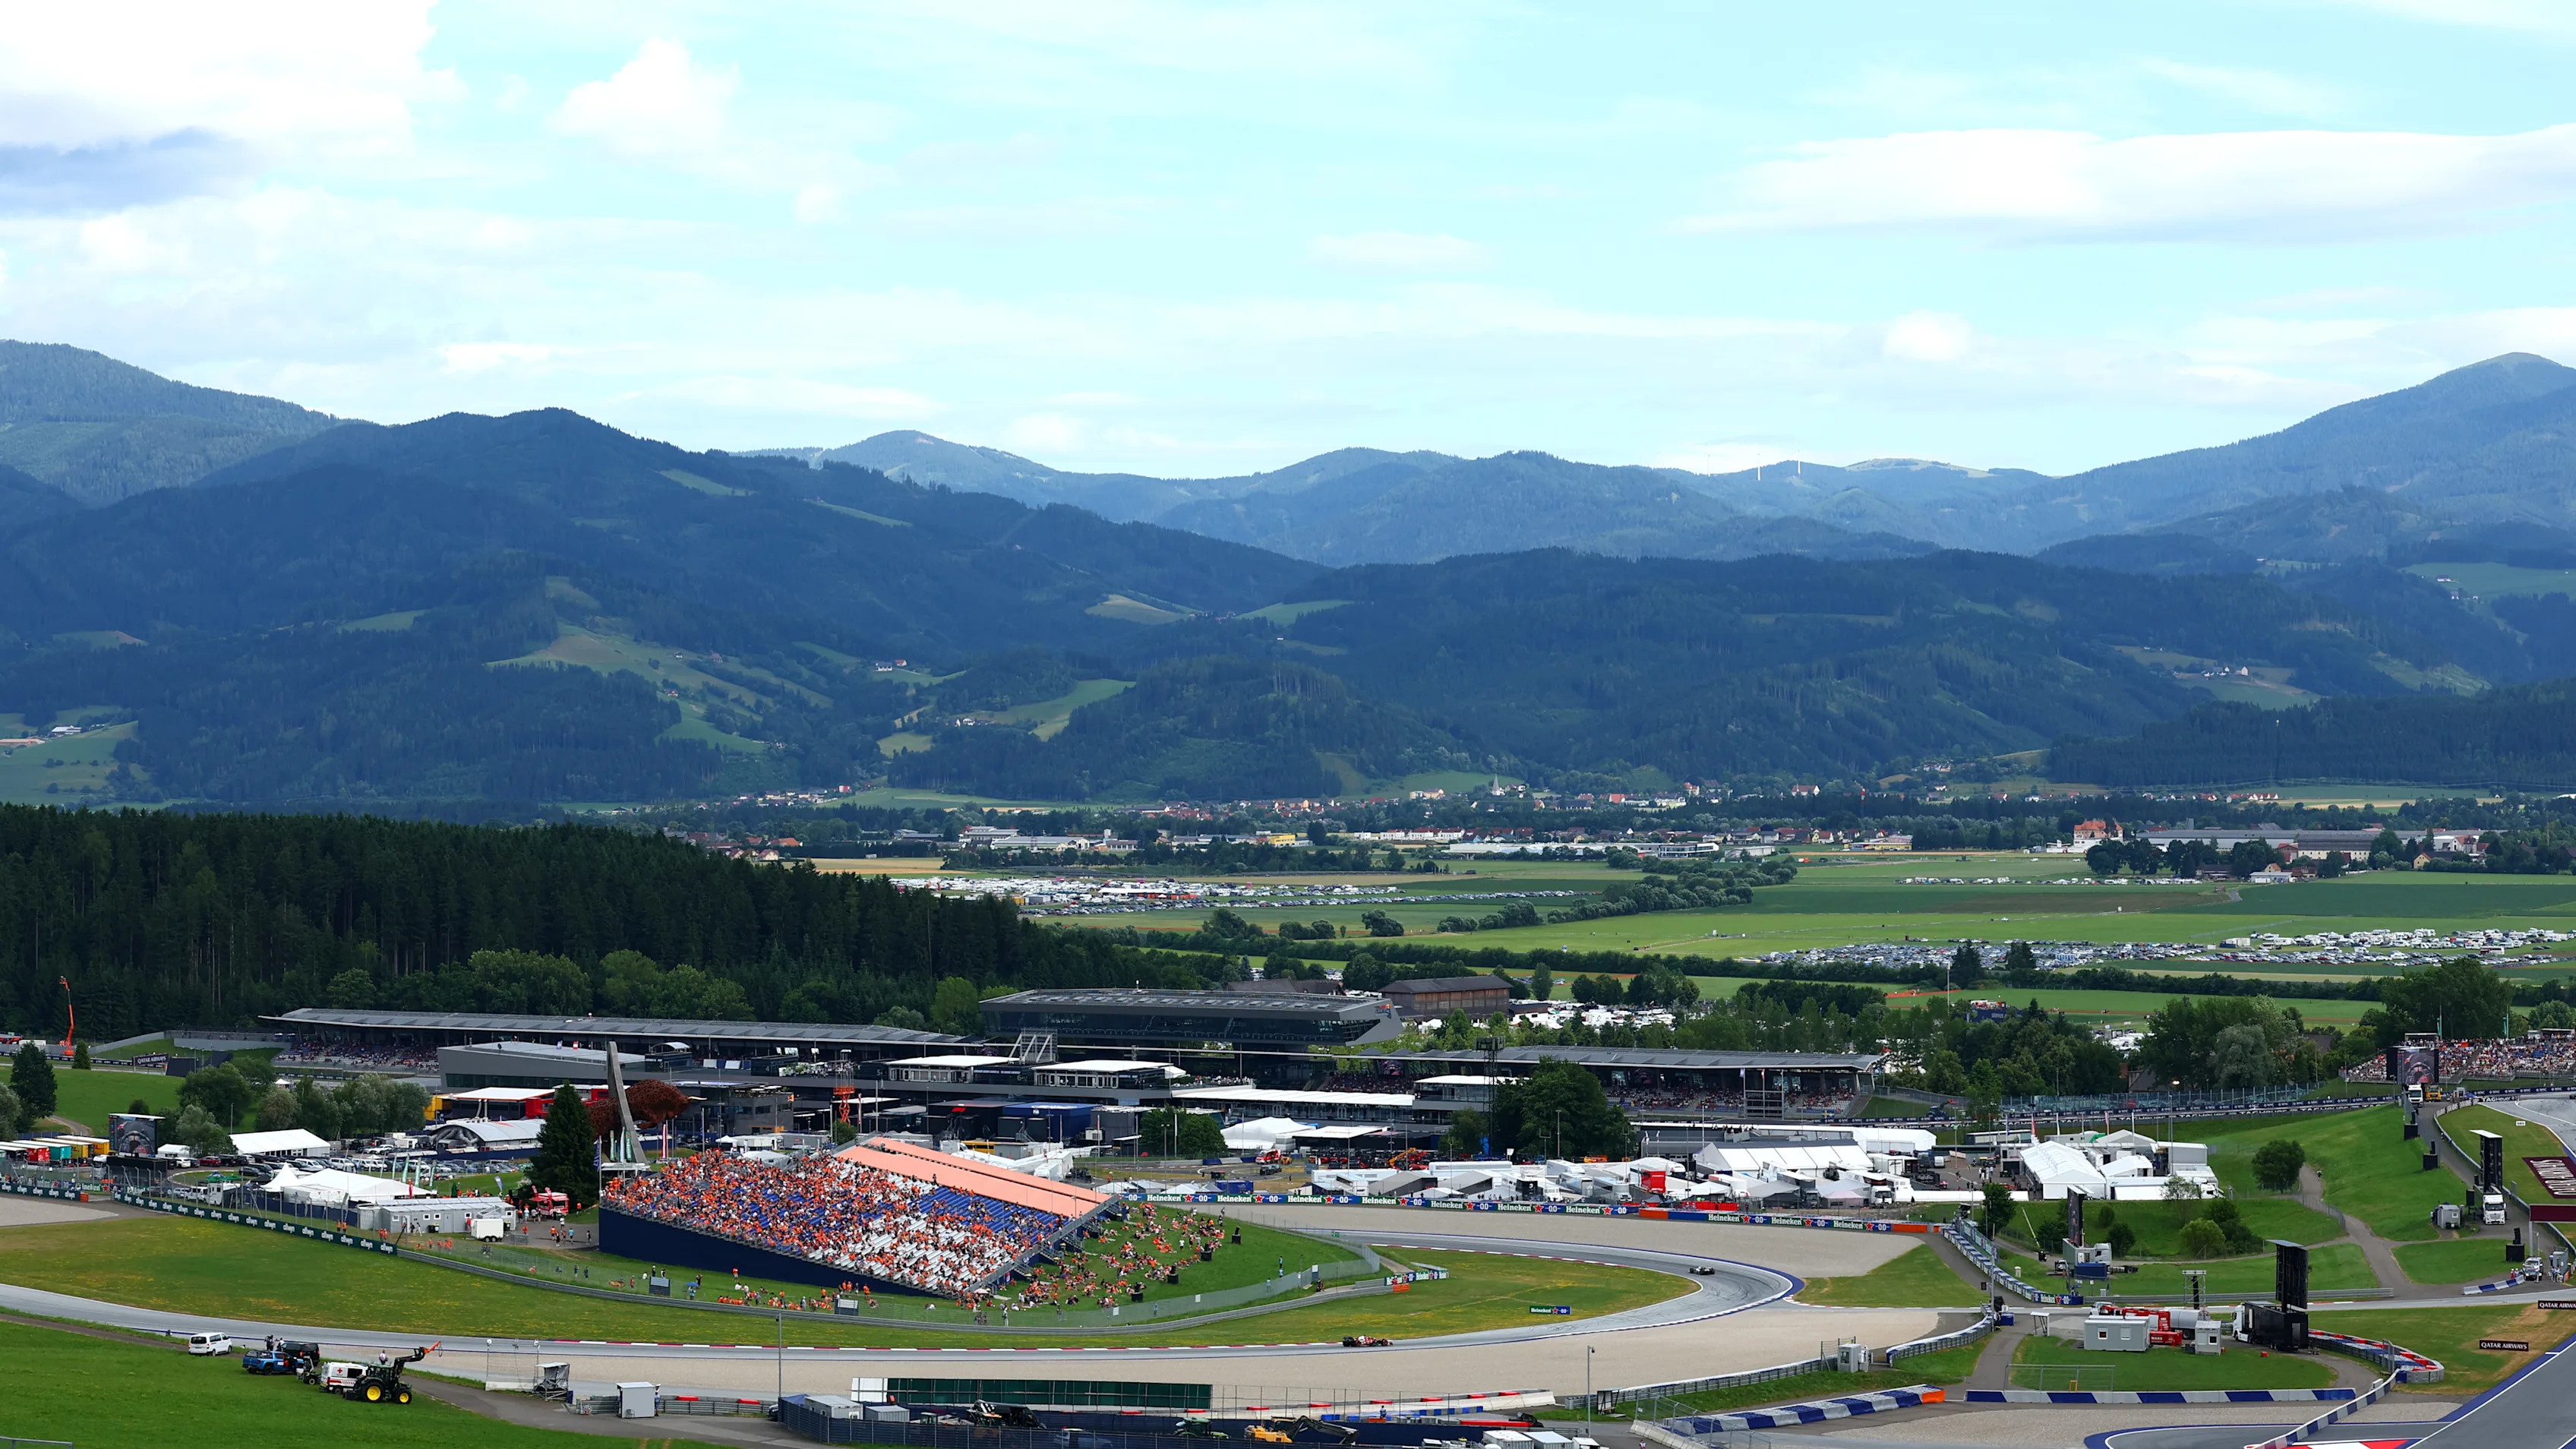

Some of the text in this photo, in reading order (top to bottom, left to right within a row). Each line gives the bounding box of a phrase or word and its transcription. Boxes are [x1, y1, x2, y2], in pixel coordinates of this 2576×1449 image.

[1431, 1201, 1463, 1209] Heineken
[1498, 1204, 1532, 1212] Heineken
[1566, 1206, 1600, 1214] Heineken
[1771, 1217, 1802, 1225] Heineken
[1833, 1221, 1863, 1230] Heineken
